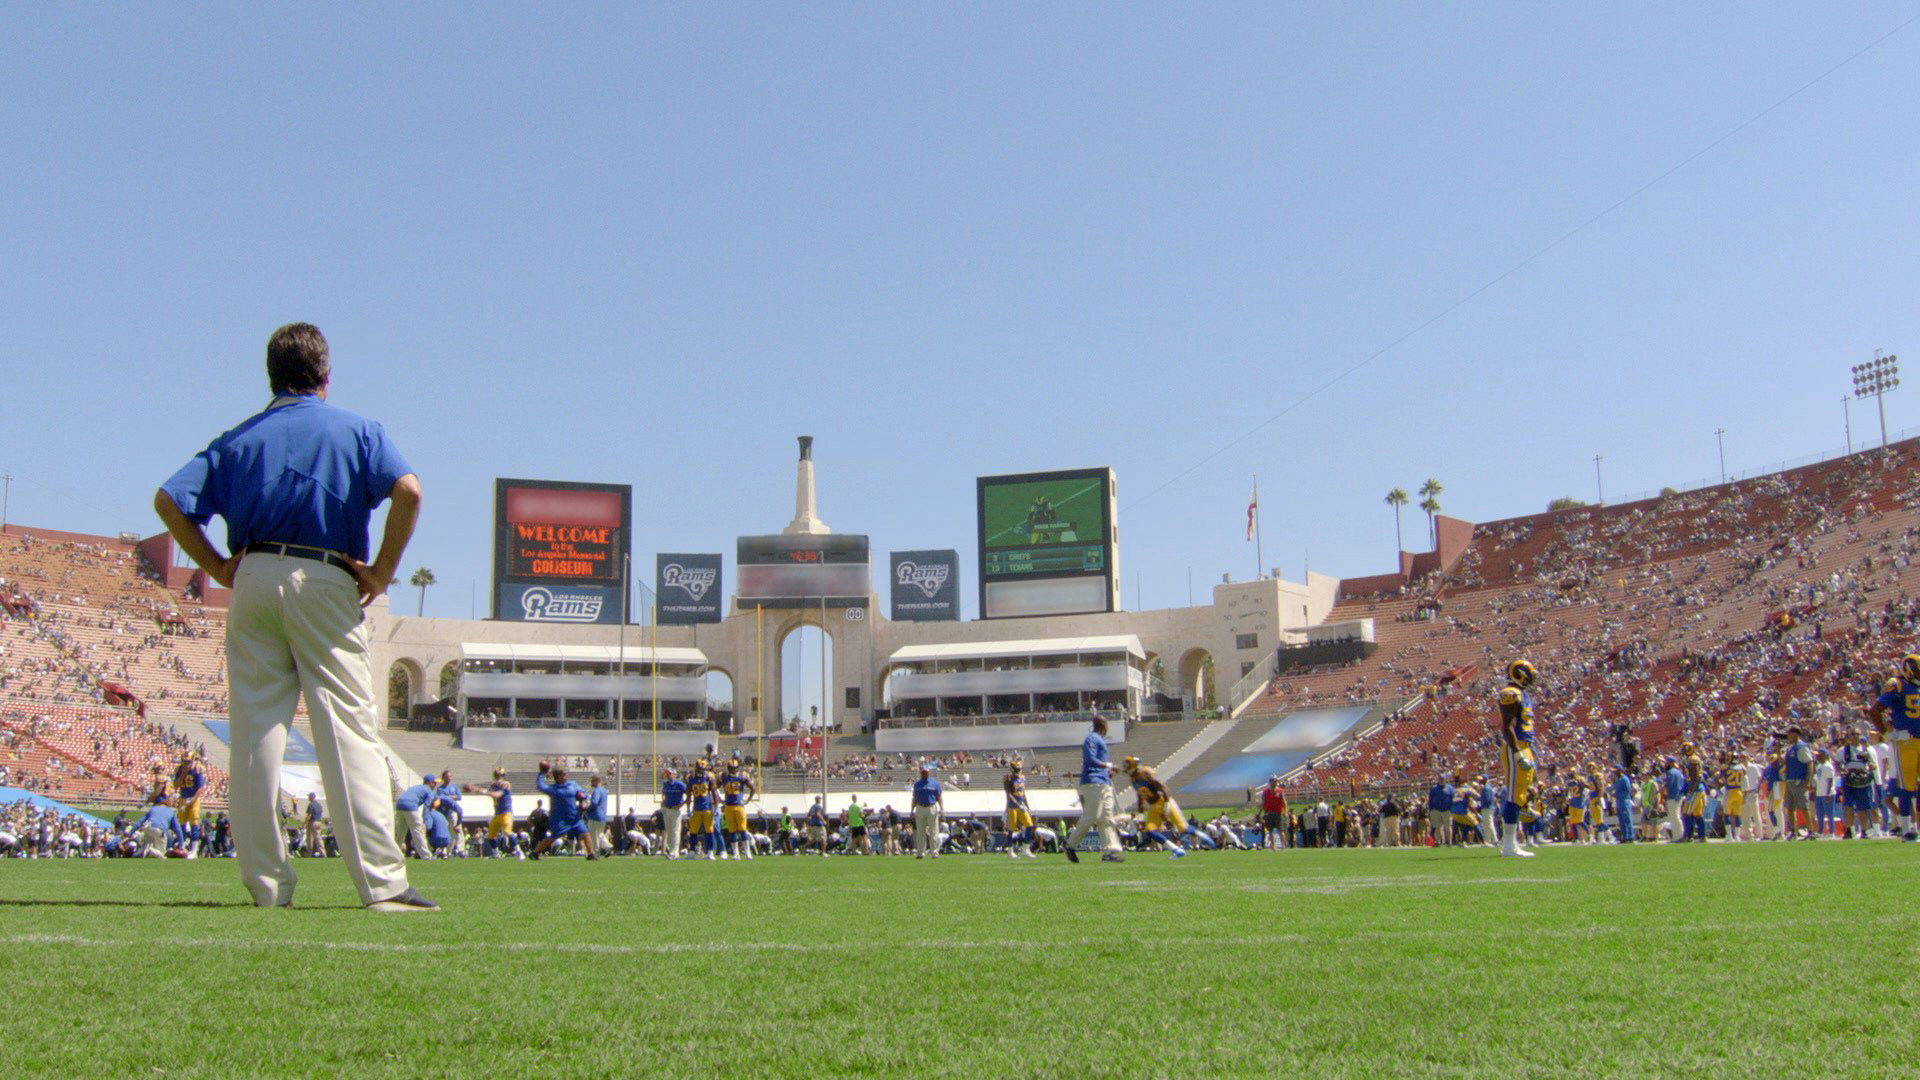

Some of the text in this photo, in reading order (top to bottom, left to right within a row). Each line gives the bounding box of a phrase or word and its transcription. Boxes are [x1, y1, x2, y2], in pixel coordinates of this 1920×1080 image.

[518, 526, 609, 544] WELCOME
[522, 549, 535, 558] Los
[532, 560, 593, 575] COLISEUM
[663, 563, 717, 586] Rams
[897, 561, 949, 584] Rams
[522, 587, 603, 622] Rams
